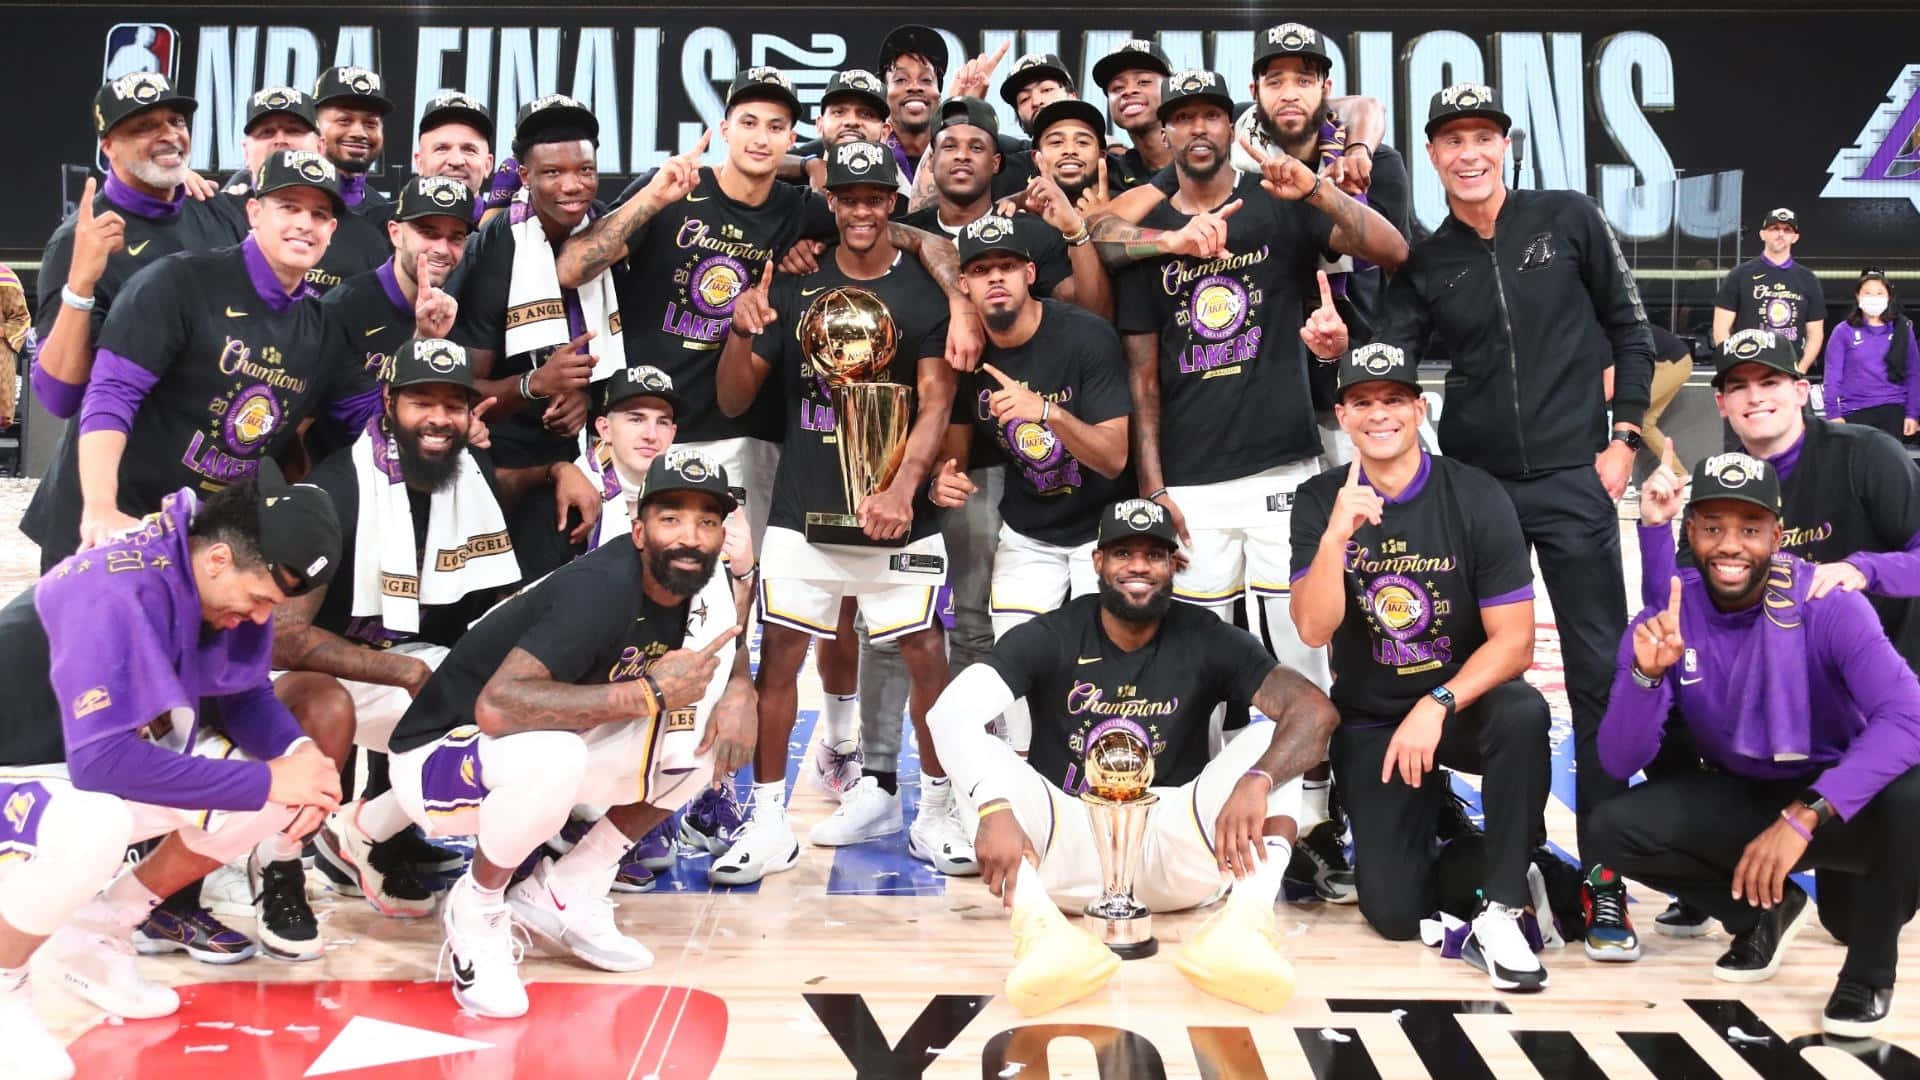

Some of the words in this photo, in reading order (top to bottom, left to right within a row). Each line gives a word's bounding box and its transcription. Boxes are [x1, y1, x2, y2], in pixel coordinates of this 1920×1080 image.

[1161, 245, 1269, 295] Champions
[219, 336, 311, 395] Champions
[1178, 326, 1262, 374] LAKERS
[1344, 540, 1456, 575] Champions
[1433, 600, 1451, 615] 20
[1068, 680, 1178, 719] Champions
